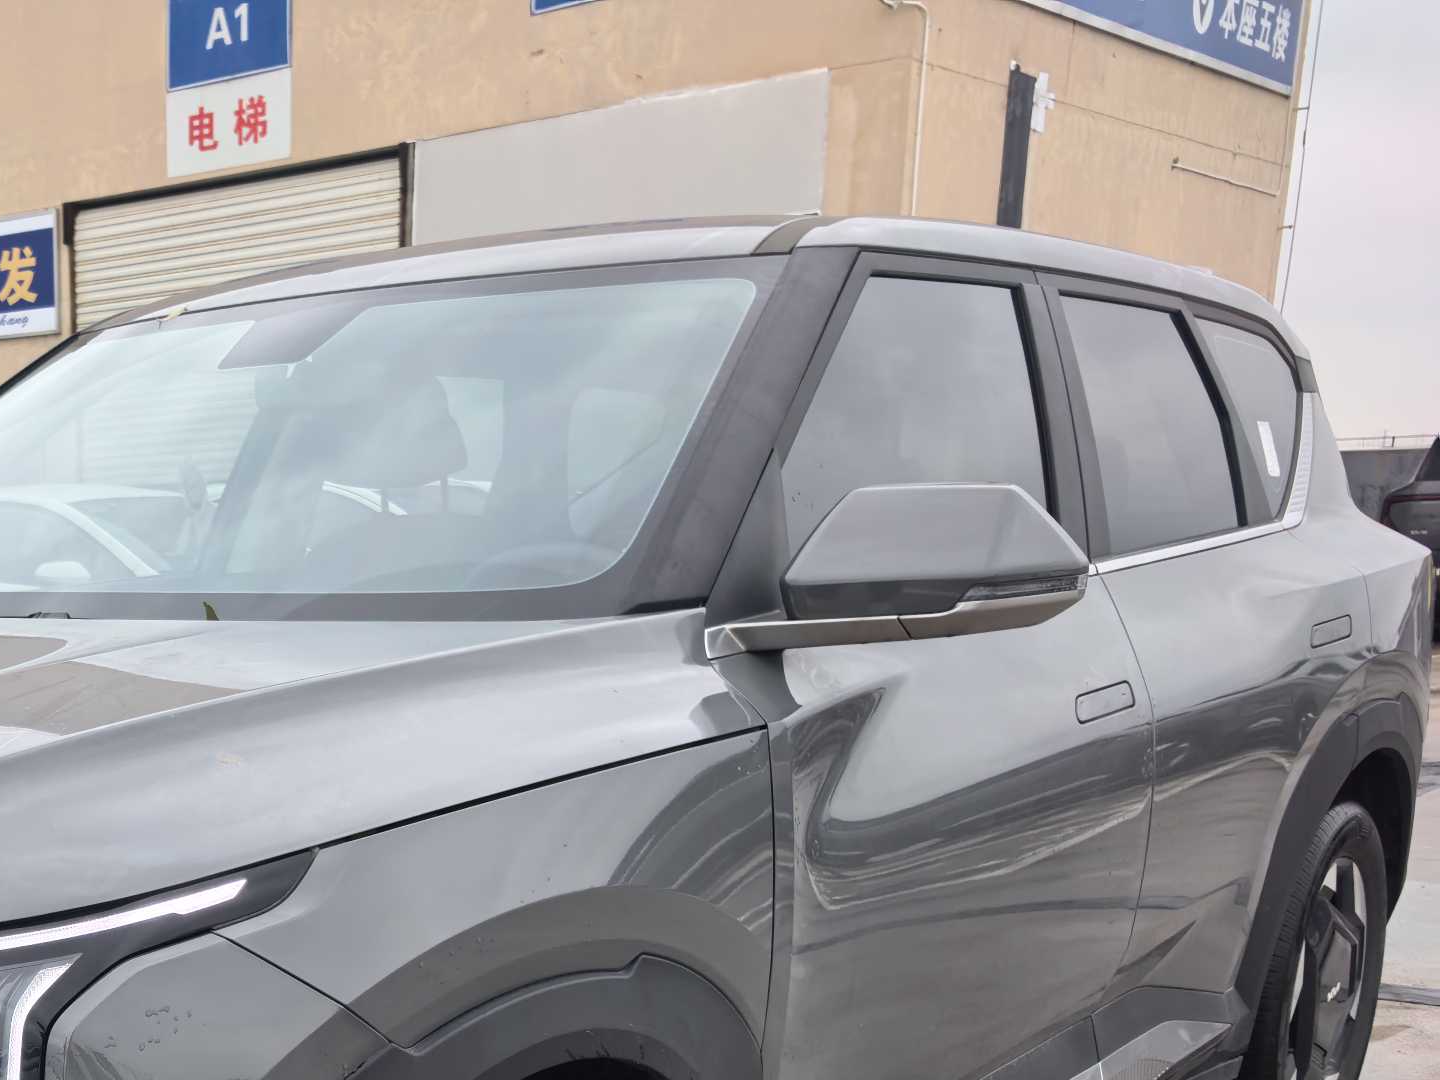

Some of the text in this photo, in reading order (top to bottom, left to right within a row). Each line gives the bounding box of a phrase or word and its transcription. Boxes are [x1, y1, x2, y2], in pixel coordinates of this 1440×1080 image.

[205, 3, 249, 50] A1
[1218, 0, 1291, 62] 本座五楼
[187, 94, 268, 153] 电梯
